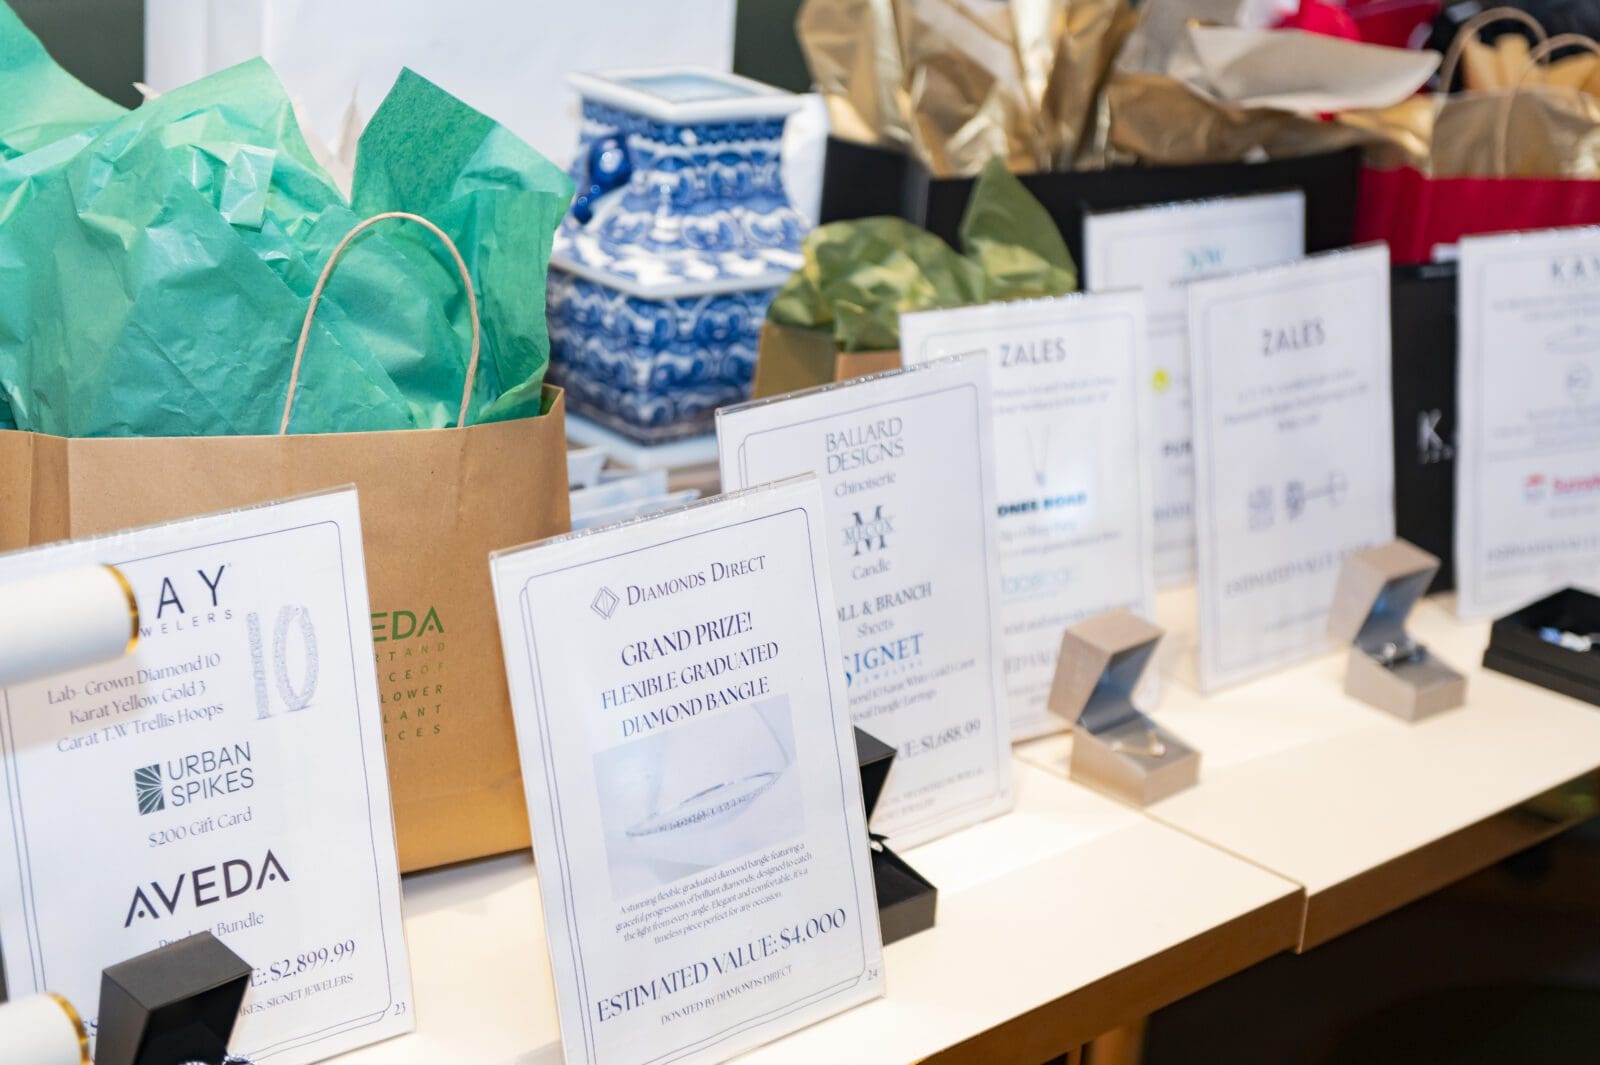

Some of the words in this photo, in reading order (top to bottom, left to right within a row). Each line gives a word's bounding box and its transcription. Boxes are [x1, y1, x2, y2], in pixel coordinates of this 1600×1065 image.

[1000, 337, 1067, 368] ZALES
[1261, 317, 1326, 357] ZALES
[826, 417, 903, 453] BALLARD
[827, 437, 904, 475] DESIGNS
[852, 558, 892, 581] Candle
[157, 565, 226, 620] AY
[862, 601, 873, 616] &
[876, 582, 932, 613] BRANCH
[140, 609, 233, 638] WELERS
[371, 606, 445, 643] EDA
[621, 629, 691, 667] GRAND
[695, 611, 753, 645] PRIZE!
[857, 620, 895, 639] Sheets
[84, 673, 135, 696] Grown
[136, 655, 203, 684] Diamond
[205, 652, 221, 669] 10
[381, 684, 443, 704] LOWER
[601, 671, 679, 710] FLEXIBLE
[680, 641, 779, 685] GRADUATED
[70, 704, 110, 725] Karat
[112, 692, 160, 715] Yellow
[162, 680, 196, 703] Gold
[198, 680, 206, 696] 3
[383, 704, 441, 724] LANT
[622, 697, 703, 738] DIAMOND
[705, 676, 770, 711] BANGLE
[57, 731, 99, 753] Carat
[133, 712, 176, 736] Trellis
[177, 703, 224, 724] Hoops
[168, 741, 252, 781] URBAN
[171, 767, 255, 807] SPIKES
[149, 826, 187, 848] $200
[190, 817, 215, 837] Gift
[217, 806, 252, 829] Card
[124, 848, 290, 928] AVEDA
[616, 912, 644, 934] graceful
[645, 899, 686, 922] progression
[695, 886, 721, 902] brilliant
[756, 861, 785, 881] designed
[682, 872, 718, 896] graduated
[718, 861, 748, 880] diamond
[217, 912, 264, 937] Bundle
[624, 931, 636, 943] the
[652, 919, 670, 932] from
[737, 887, 751, 900] and
[655, 928, 683, 945] timeless
[683, 921, 703, 936] piece
[702, 911, 728, 930] perfect
[250, 968, 267, 988] E:
[269, 939, 356, 982] $2,899.99
[597, 962, 709, 1023] ESTIMATED
[712, 935, 778, 976] VALUE:
[780, 908, 847, 951] $4,000
[239, 1001, 266, 1018] IKES,
[267, 988, 303, 1009] SIGNET
[304, 973, 354, 997] JEWELERS
[393, 1002, 407, 1016] 23
[661, 999, 704, 1025] DONATED
[704, 996, 716, 1009] BY
[715, 977, 762, 1002] DIAMONDS
[762, 964, 793, 986] DIRECT
